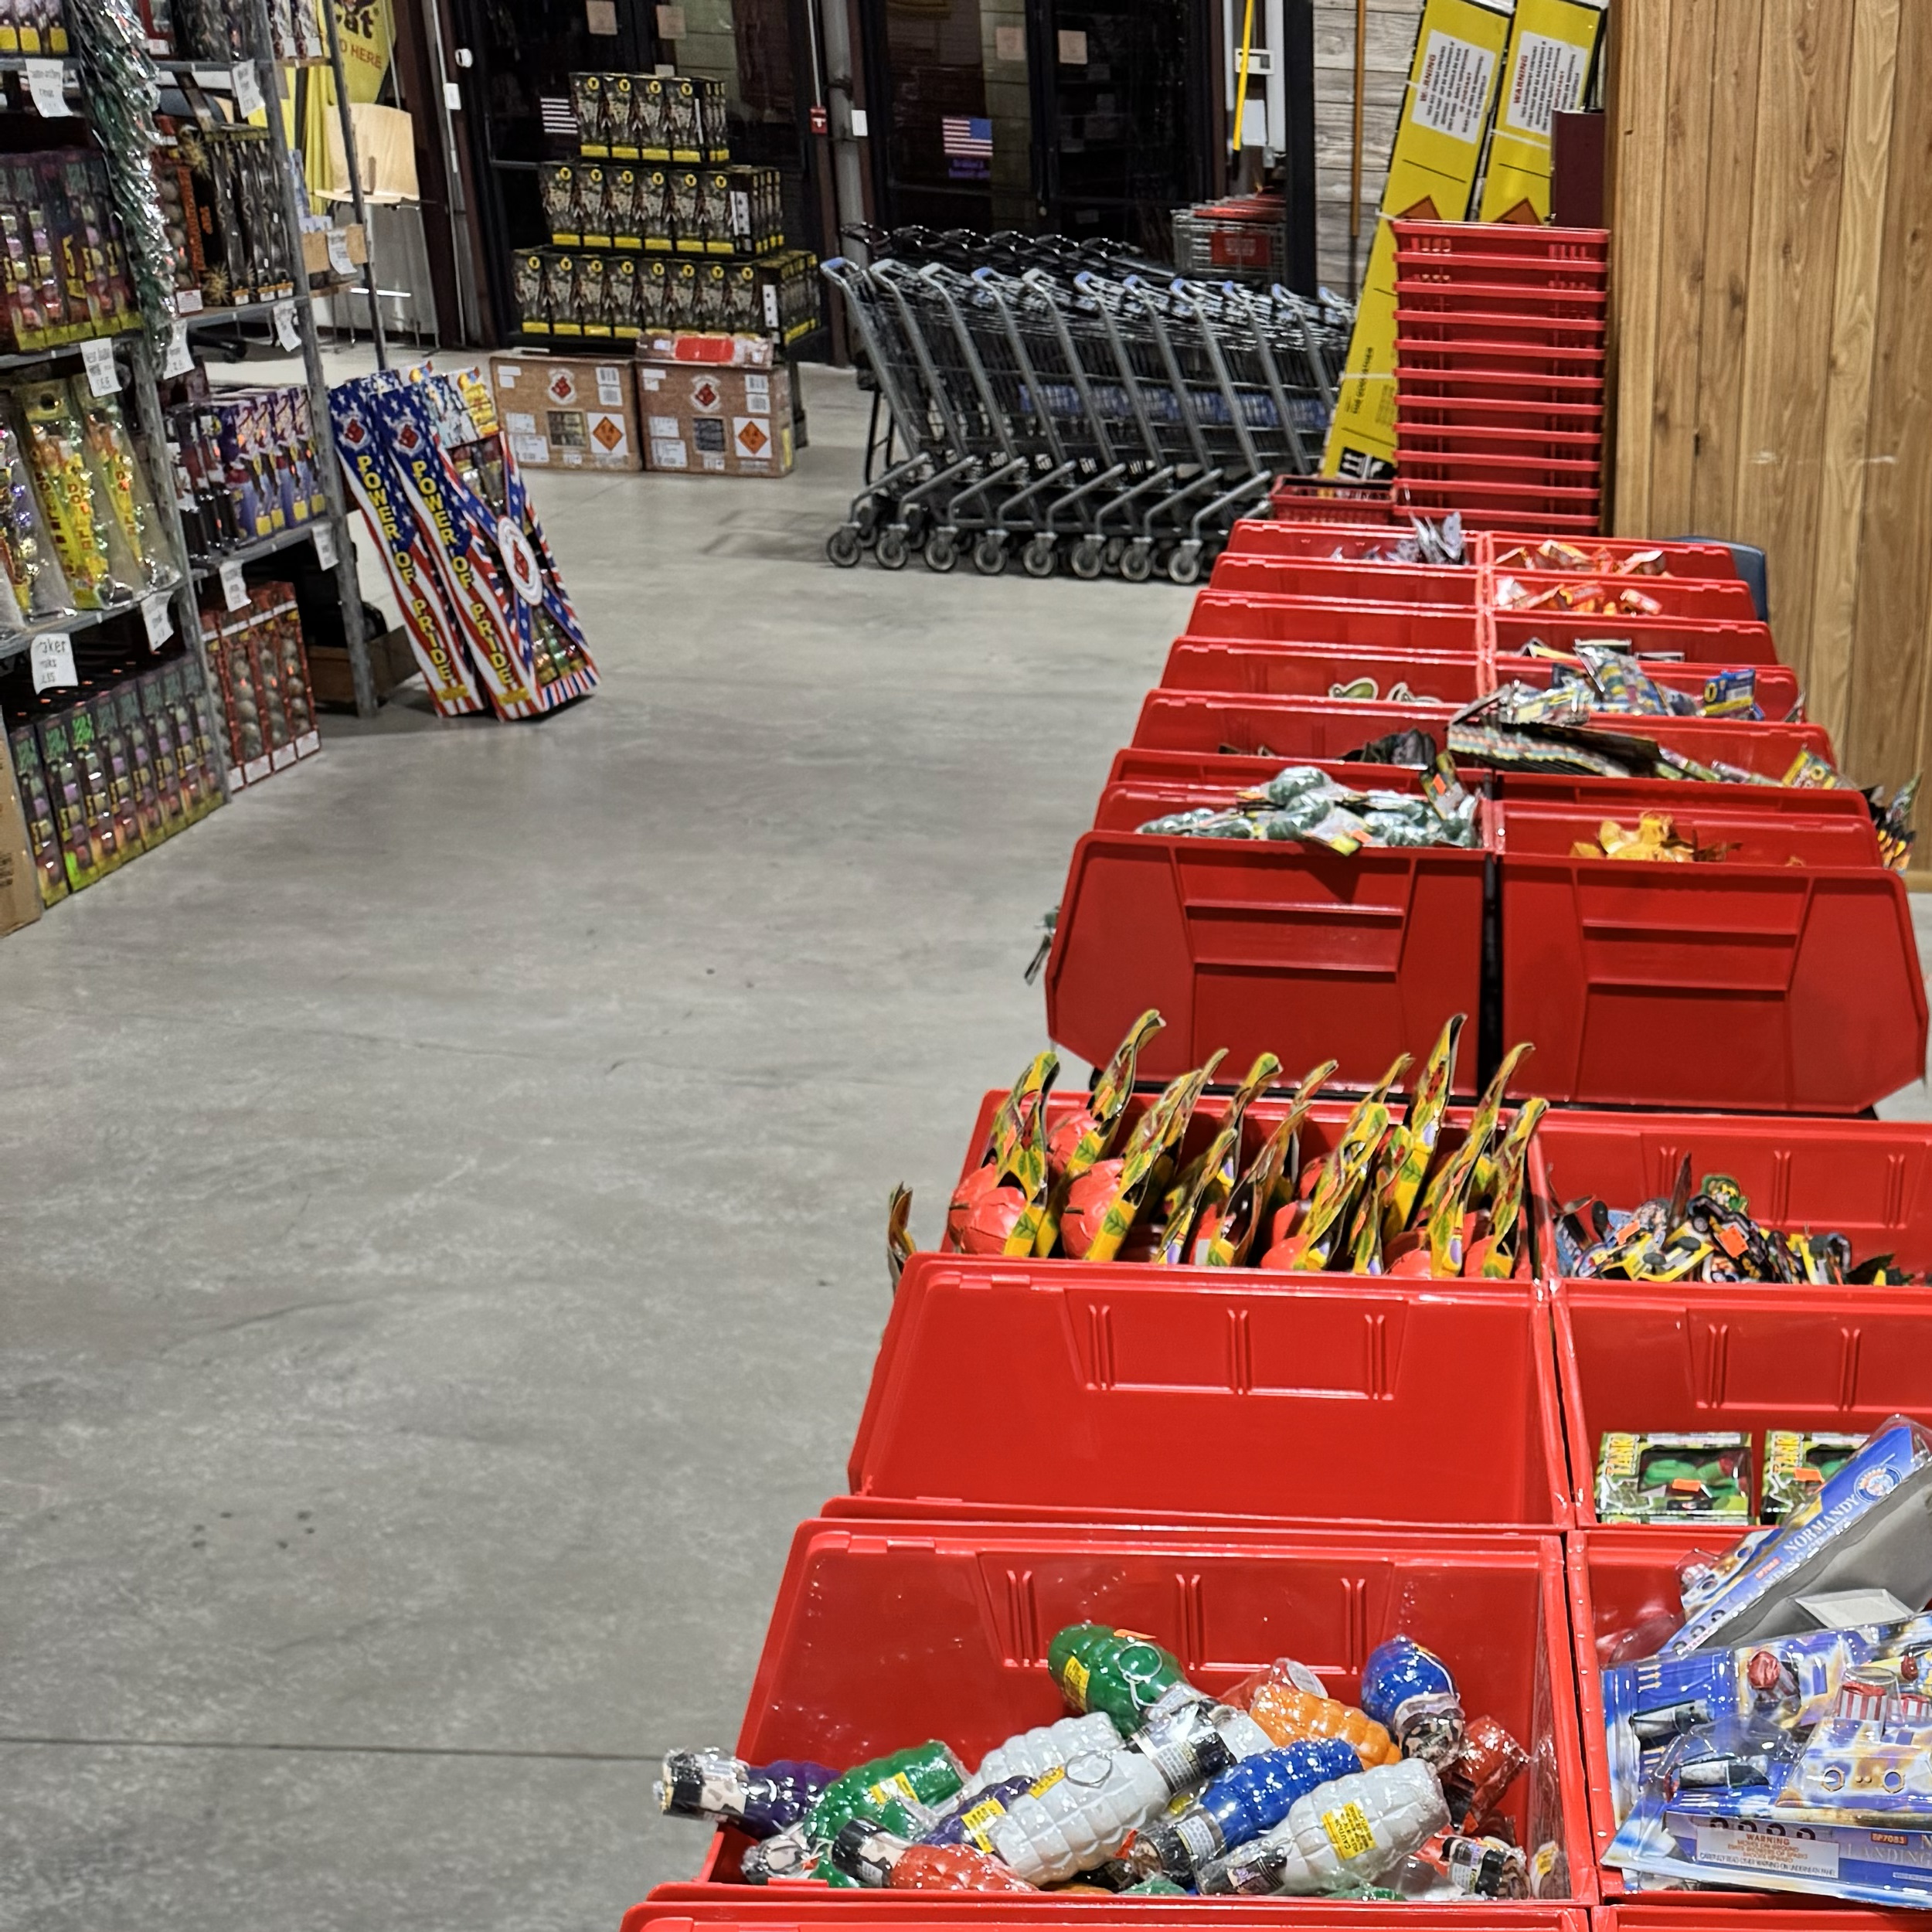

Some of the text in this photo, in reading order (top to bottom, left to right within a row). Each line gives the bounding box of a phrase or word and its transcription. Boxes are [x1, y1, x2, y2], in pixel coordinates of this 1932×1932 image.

[351, 45, 383, 70] HERE
[1513, 55, 1529, 104] WARNING
[357, 455, 402, 541] POWER
[395, 552, 417, 585] OF
[412, 599, 454, 681] PRIDE
[412, 461, 513, 685] POWER OF PRIDE
[1607, 1436, 1635, 1475] TANK
[1773, 1436, 1801, 1473] TANK
[1784, 1495, 1859, 1556] NORMANDY
[1747, 1833, 1791, 1845] WARNING
[1847, 1844, 1932, 1866] LANDING
